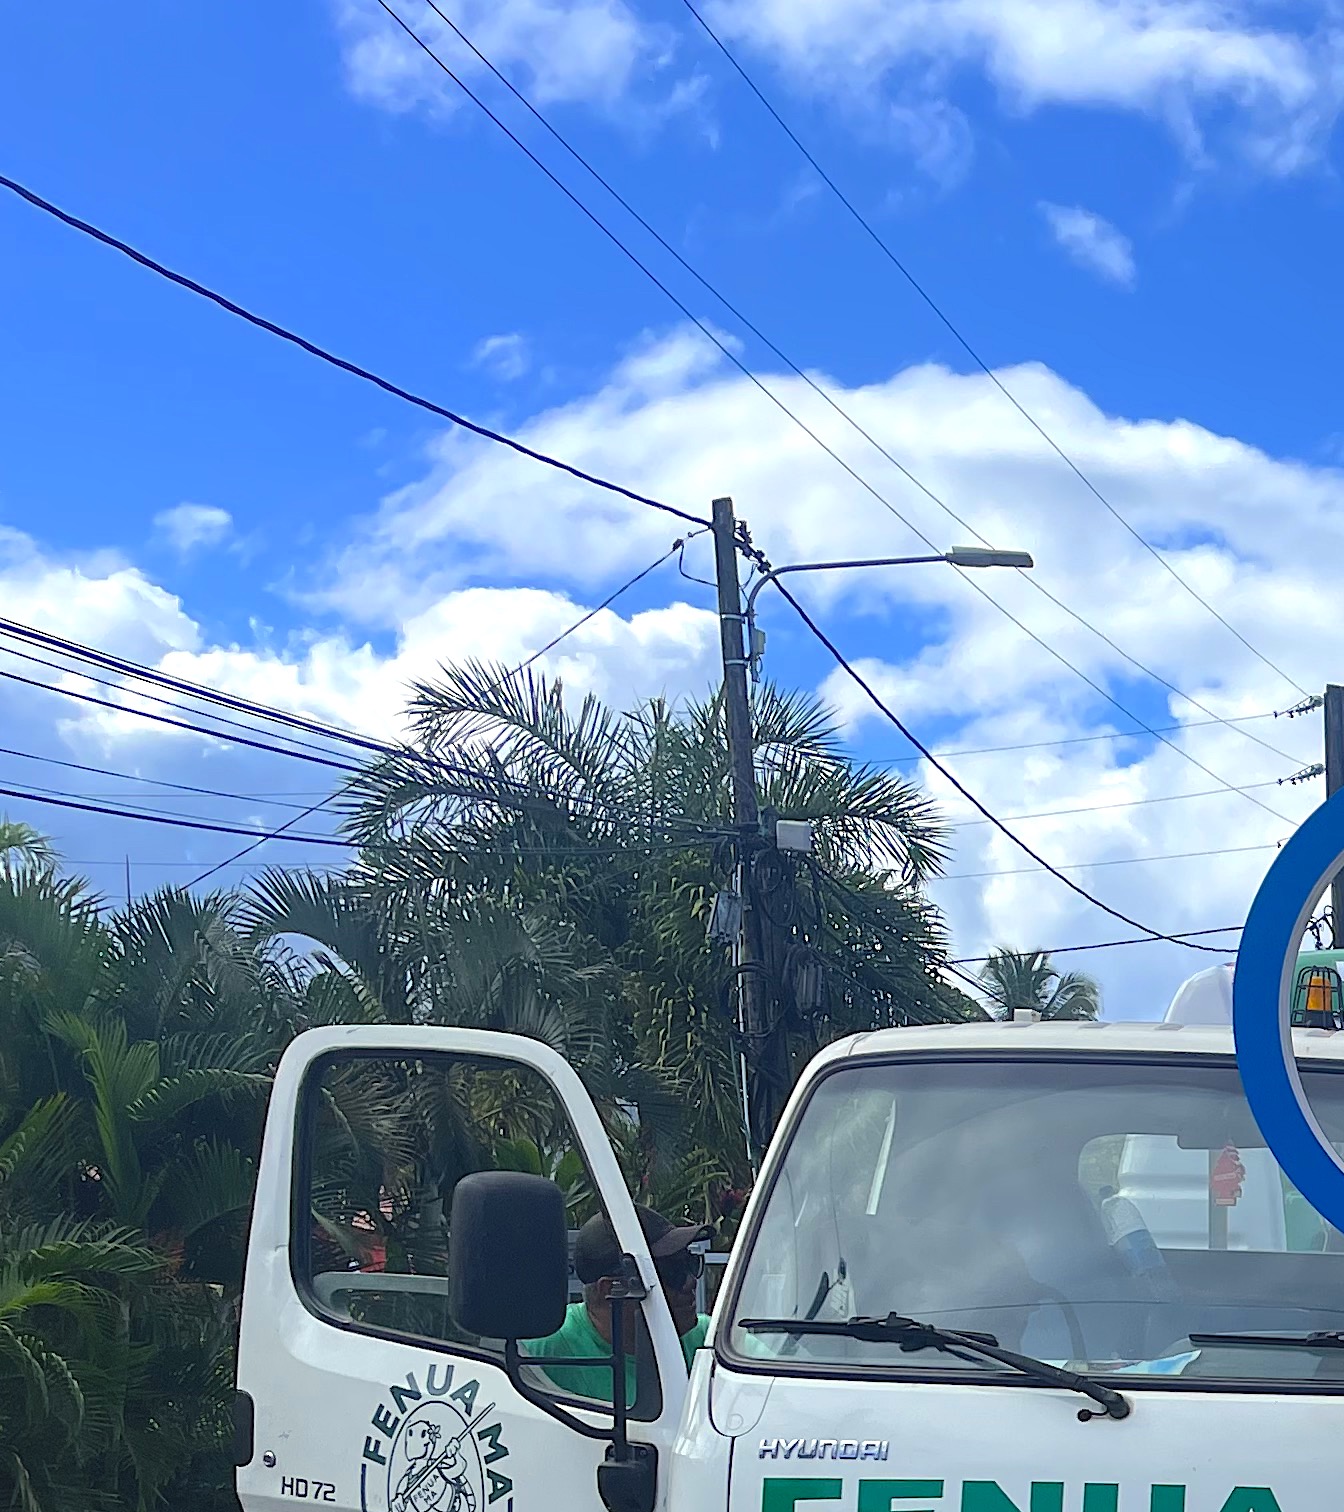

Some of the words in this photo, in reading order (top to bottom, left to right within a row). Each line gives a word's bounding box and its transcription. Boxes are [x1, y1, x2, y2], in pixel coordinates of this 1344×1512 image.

[363, 1364, 480, 1466] FENUA
[477, 1422, 514, 1505] MA
[758, 1438, 889, 1461] HYUNDAI
